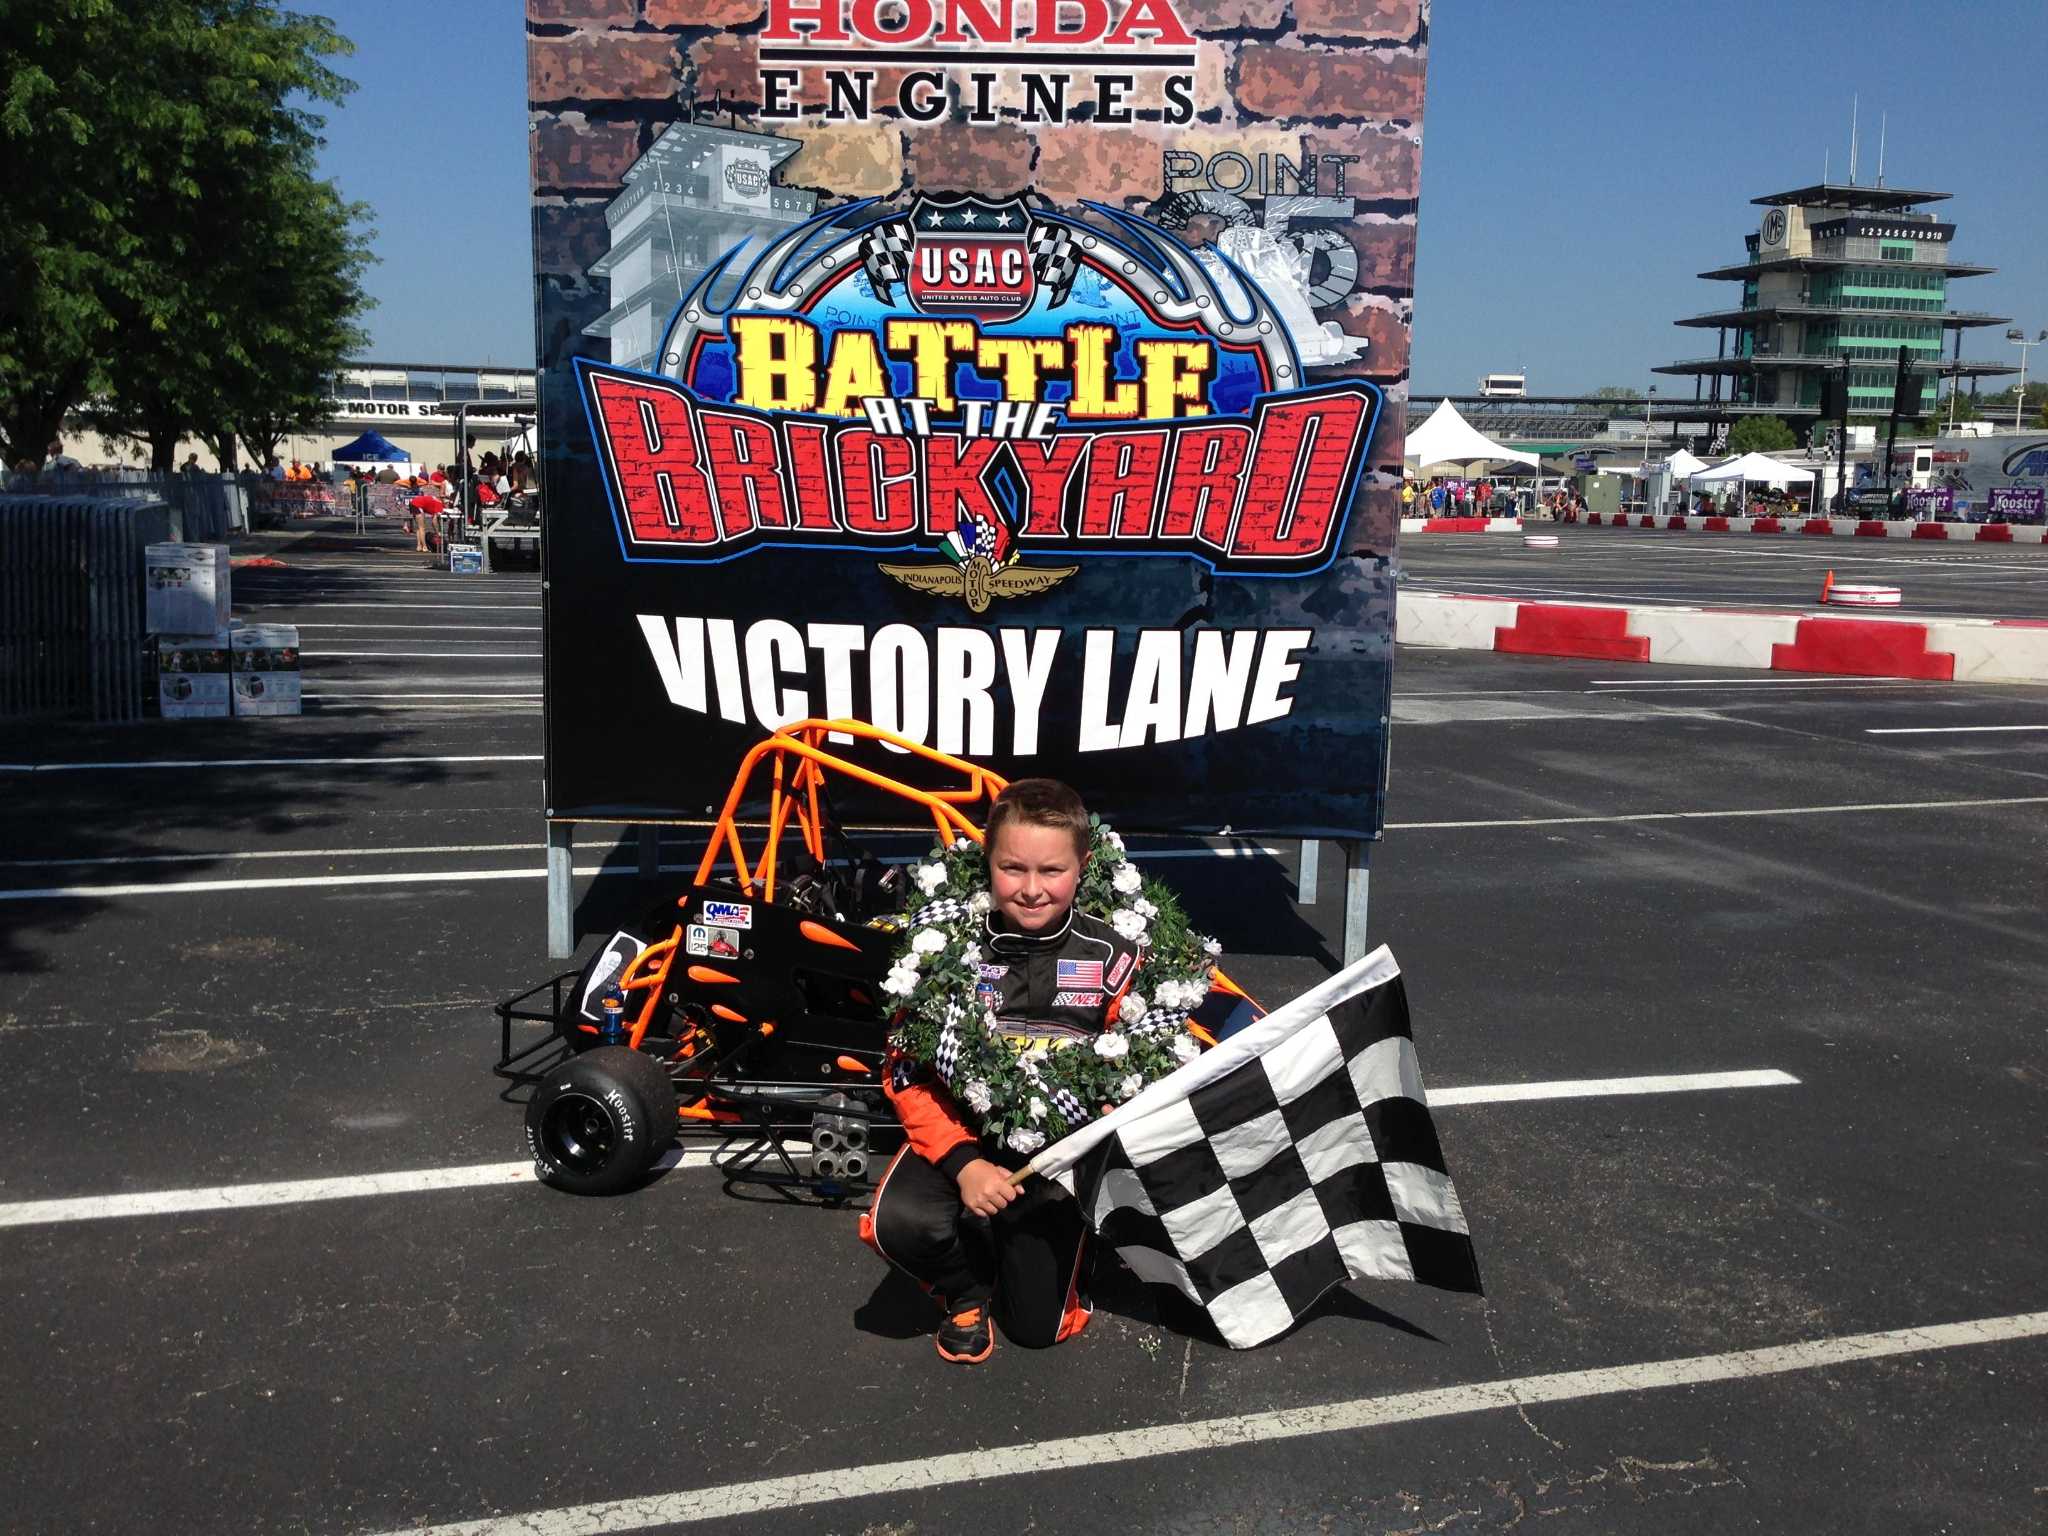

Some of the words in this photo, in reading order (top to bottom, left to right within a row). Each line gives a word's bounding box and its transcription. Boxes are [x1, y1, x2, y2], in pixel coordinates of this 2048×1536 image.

[760, 0, 1198, 45] HONDA
[759, 70, 1195, 125] ENGINES
[737, 173, 758, 186] USAC
[1163, 150, 1361, 202] POINT
[1765, 211, 1784, 242] IMS
[921, 247, 1024, 286] USAC
[731, 317, 1210, 420] BATTLE
[348, 402, 411, 416] MOTOR
[861, 397, 936, 436] AT
[957, 399, 1067, 440] THE
[362, 453, 380, 461] ICE
[591, 373, 1369, 559] BRICKYARD
[1990, 494, 2041, 512] Hoosier
[903, 573, 962, 585] INDIANAPOLIS
[970, 561, 980, 608] MOTOR
[989, 575, 1051, 589] SPEEDWAY
[635, 614, 1062, 756] VICTORY
[1078, 629, 1312, 753] LANE
[706, 903, 740, 920] QMA
[1072, 992, 1104, 1007] INEX
[603, 1089, 635, 1142] Hoosier
